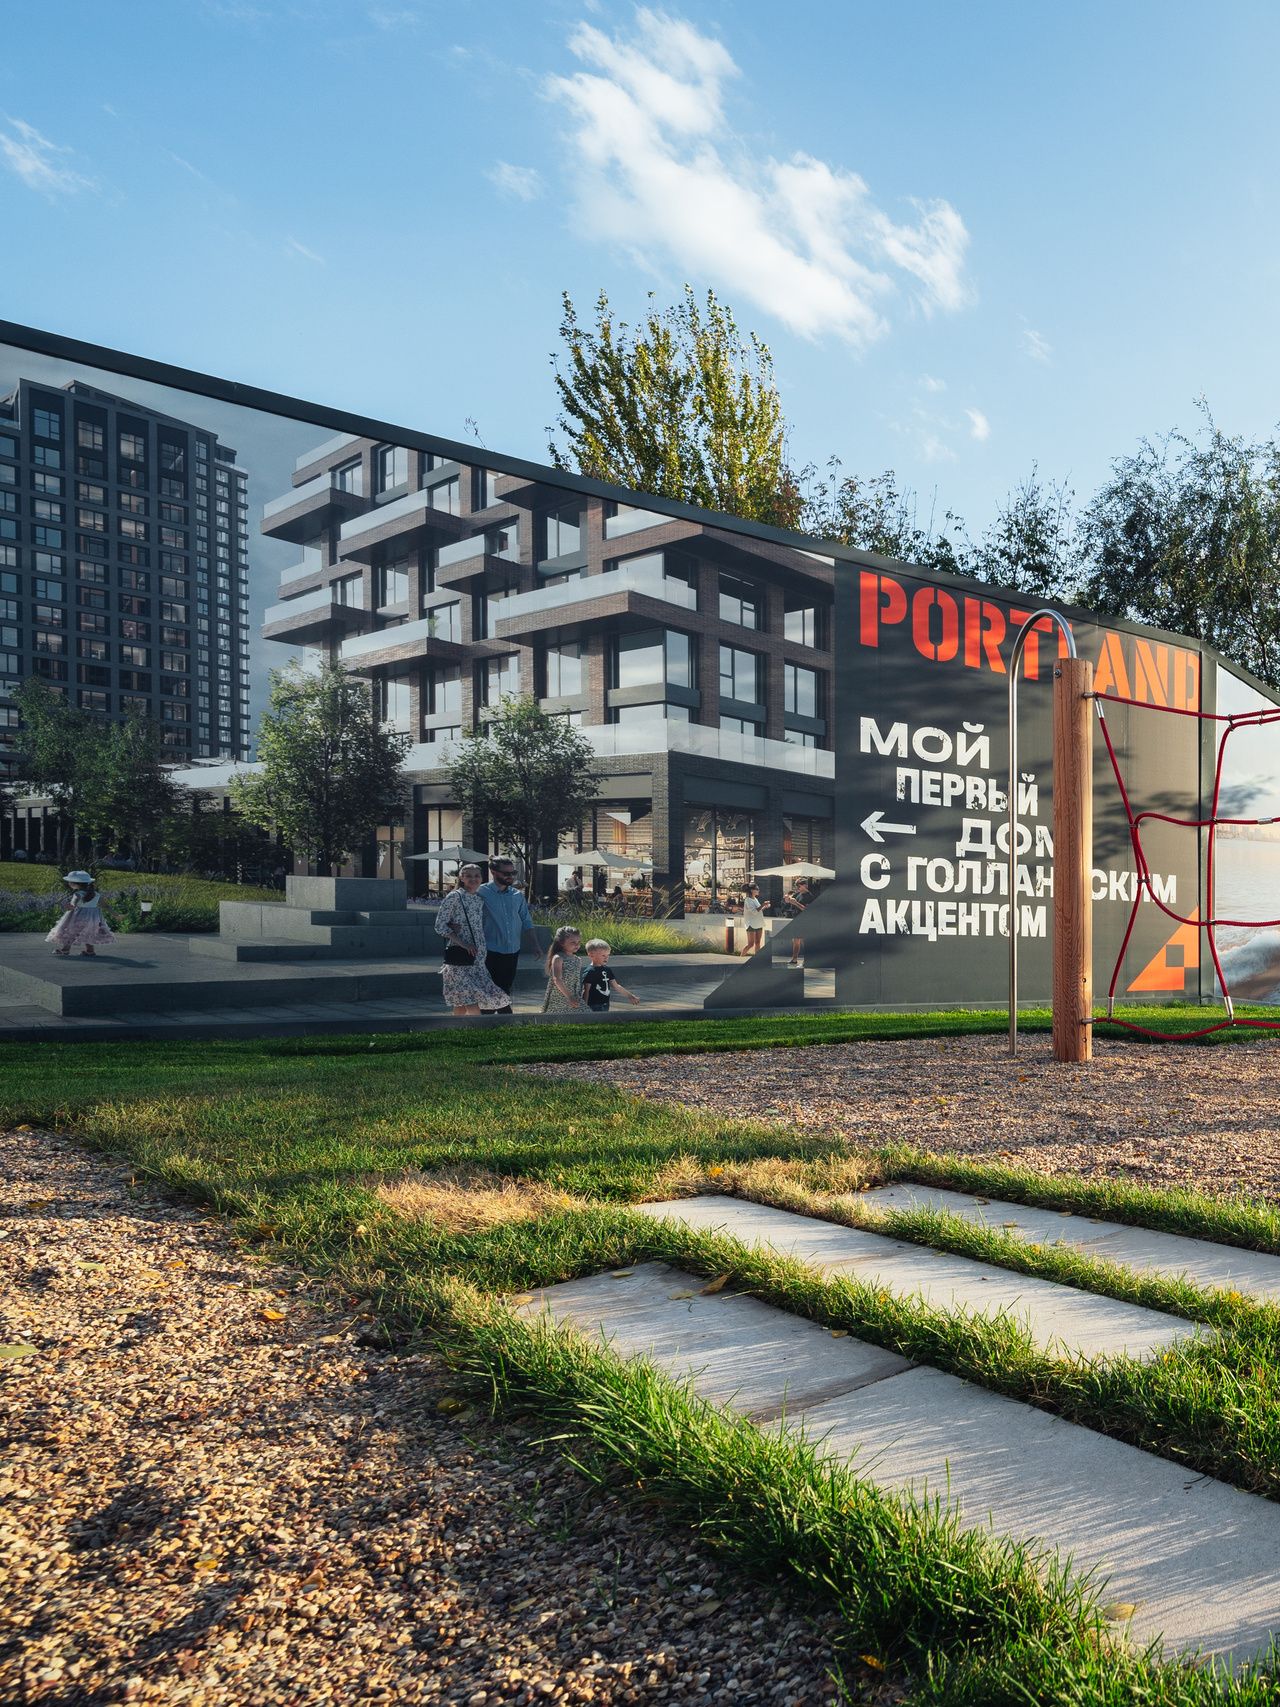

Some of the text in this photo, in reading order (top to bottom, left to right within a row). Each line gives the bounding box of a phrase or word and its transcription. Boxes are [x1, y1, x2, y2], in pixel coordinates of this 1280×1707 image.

[860, 716, 990, 769] МОЙ
[896, 767, 1039, 816] ПЕРВЫЙ
[860, 853, 1177, 904] С ГОЛЛАНСКИМ
[858, 898, 1047, 942] АКЦЕНТОМ
